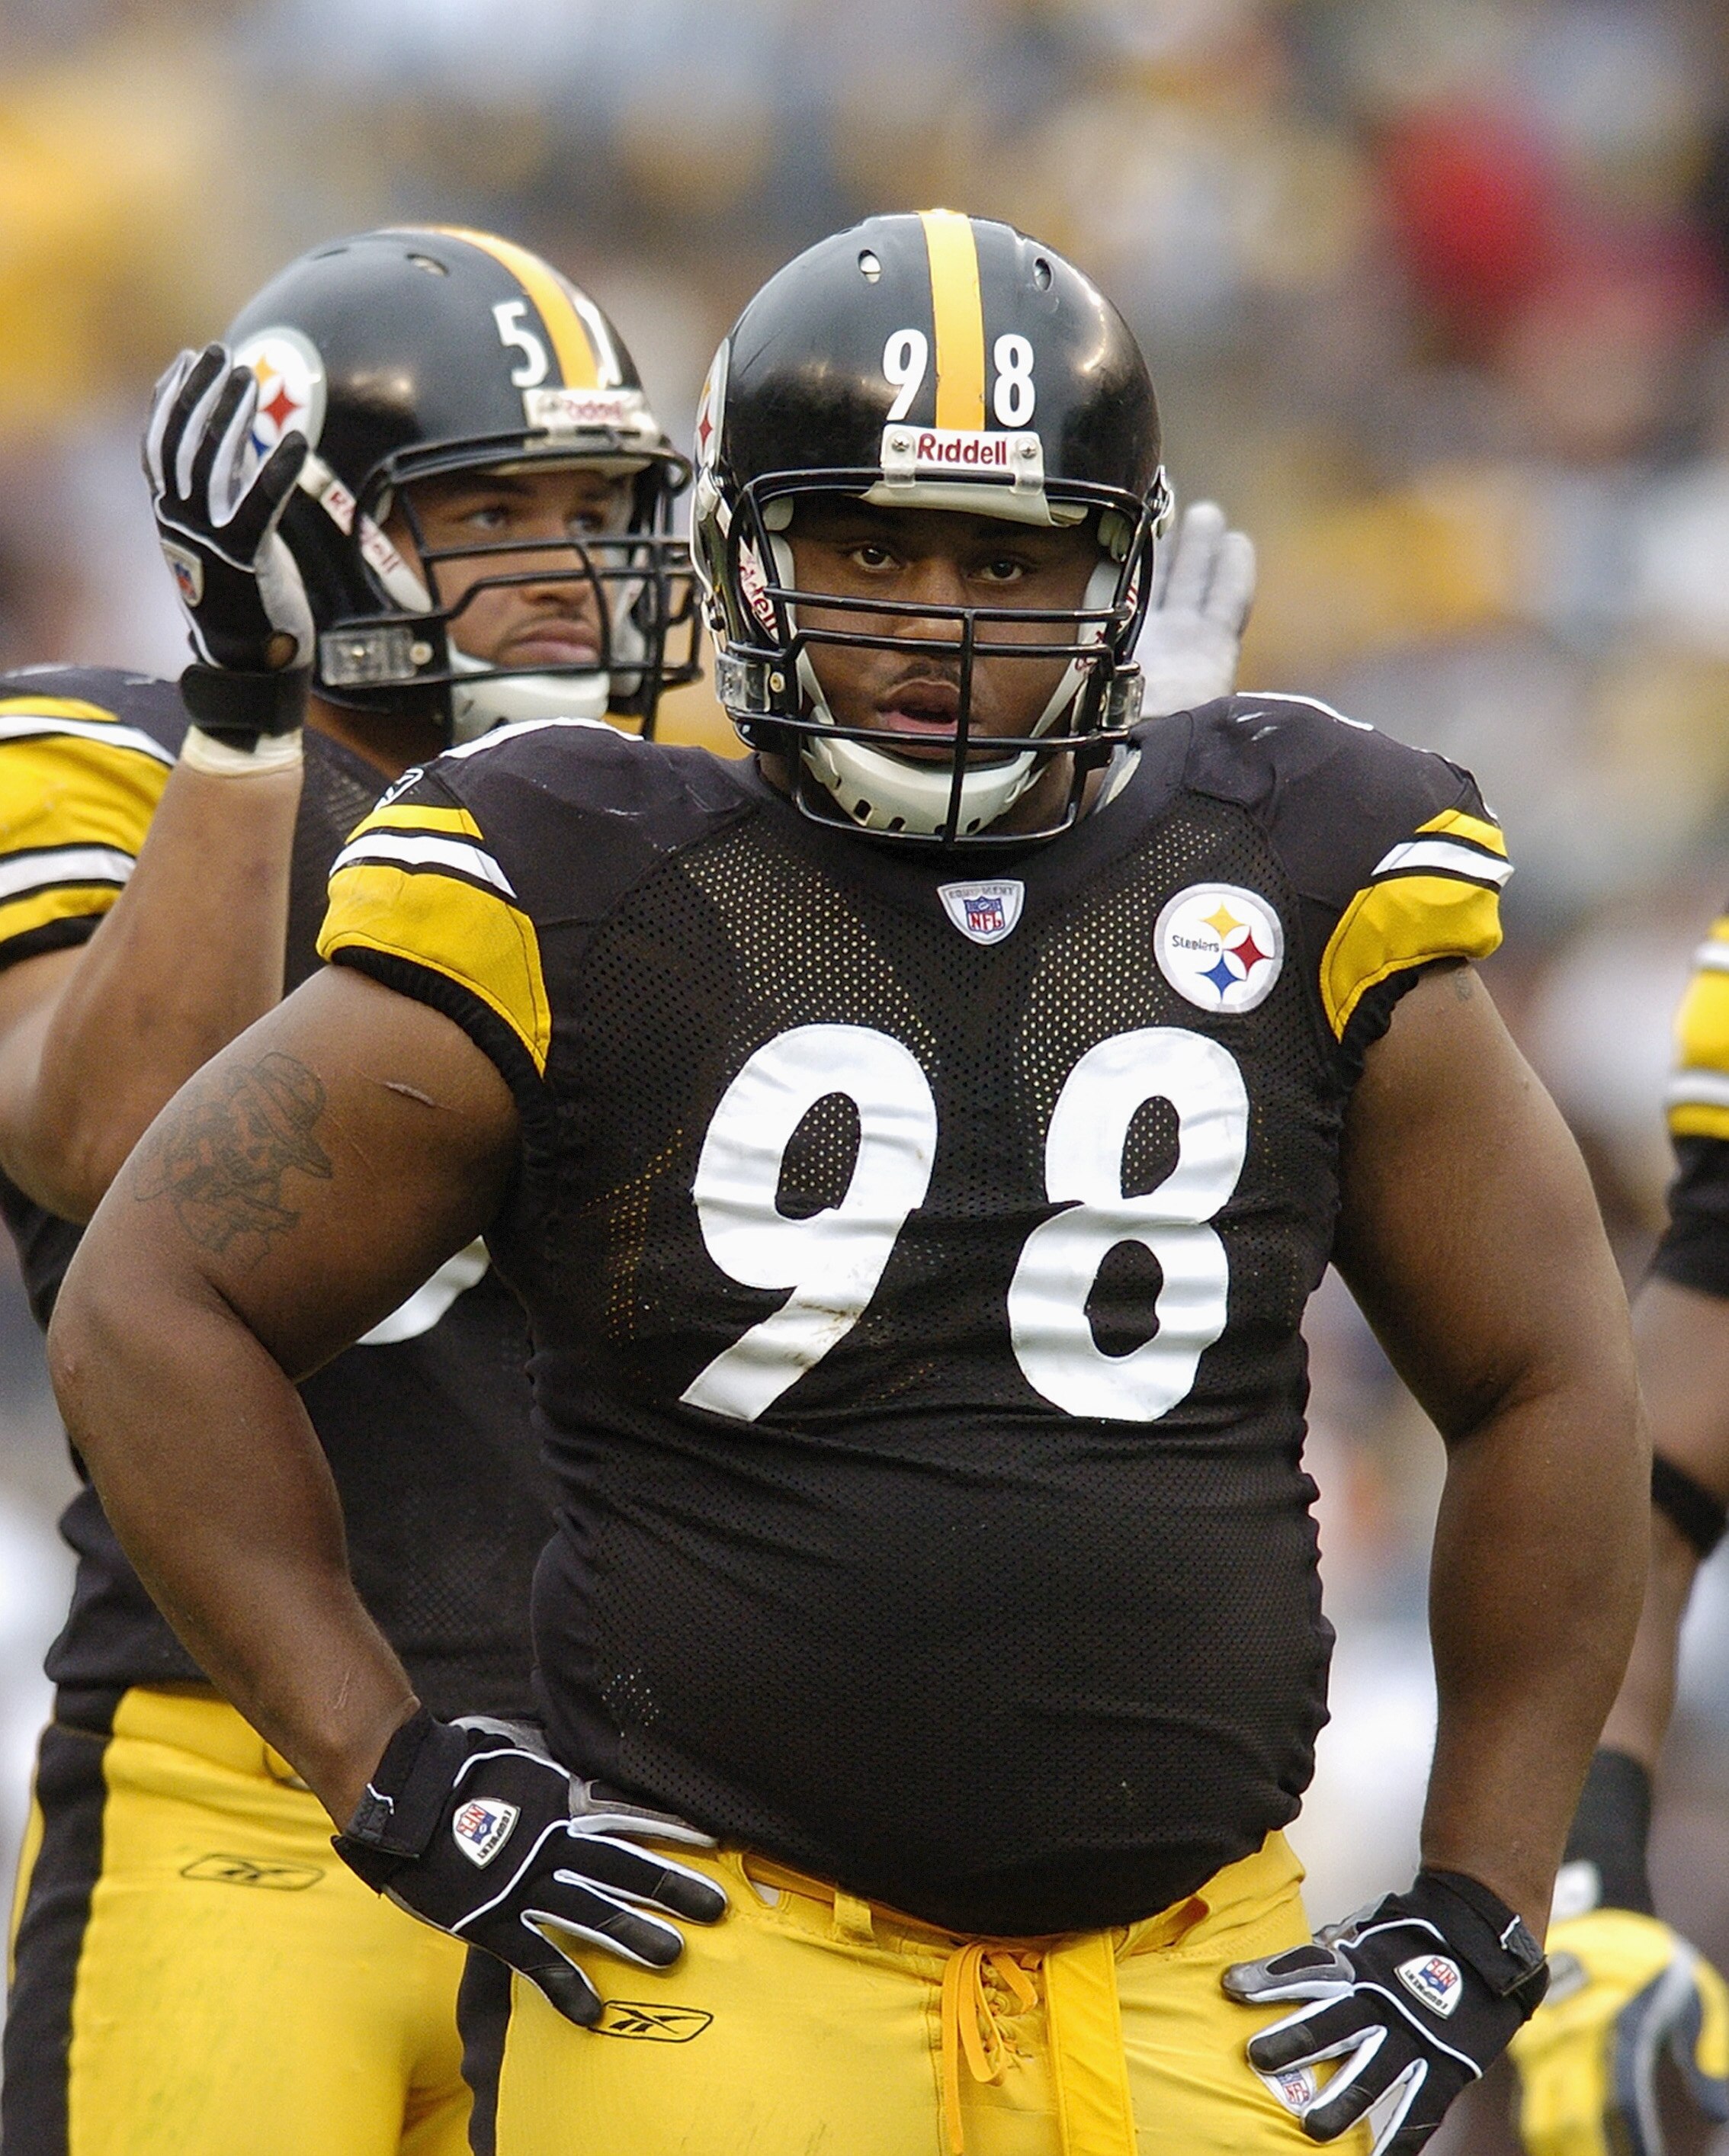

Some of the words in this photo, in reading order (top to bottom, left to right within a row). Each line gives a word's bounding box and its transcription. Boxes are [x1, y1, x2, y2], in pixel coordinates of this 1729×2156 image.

[917, 433, 1007, 466] Riddell
[969, 912, 1002, 930] NFL
[1172, 935, 1220, 953] Steelers
[679, 1023, 1250, 1423] 98
[457, 1805, 486, 1834] NFL
[1431, 1958, 1458, 1987] NFL
[1284, 2082, 1310, 2104] NFL
